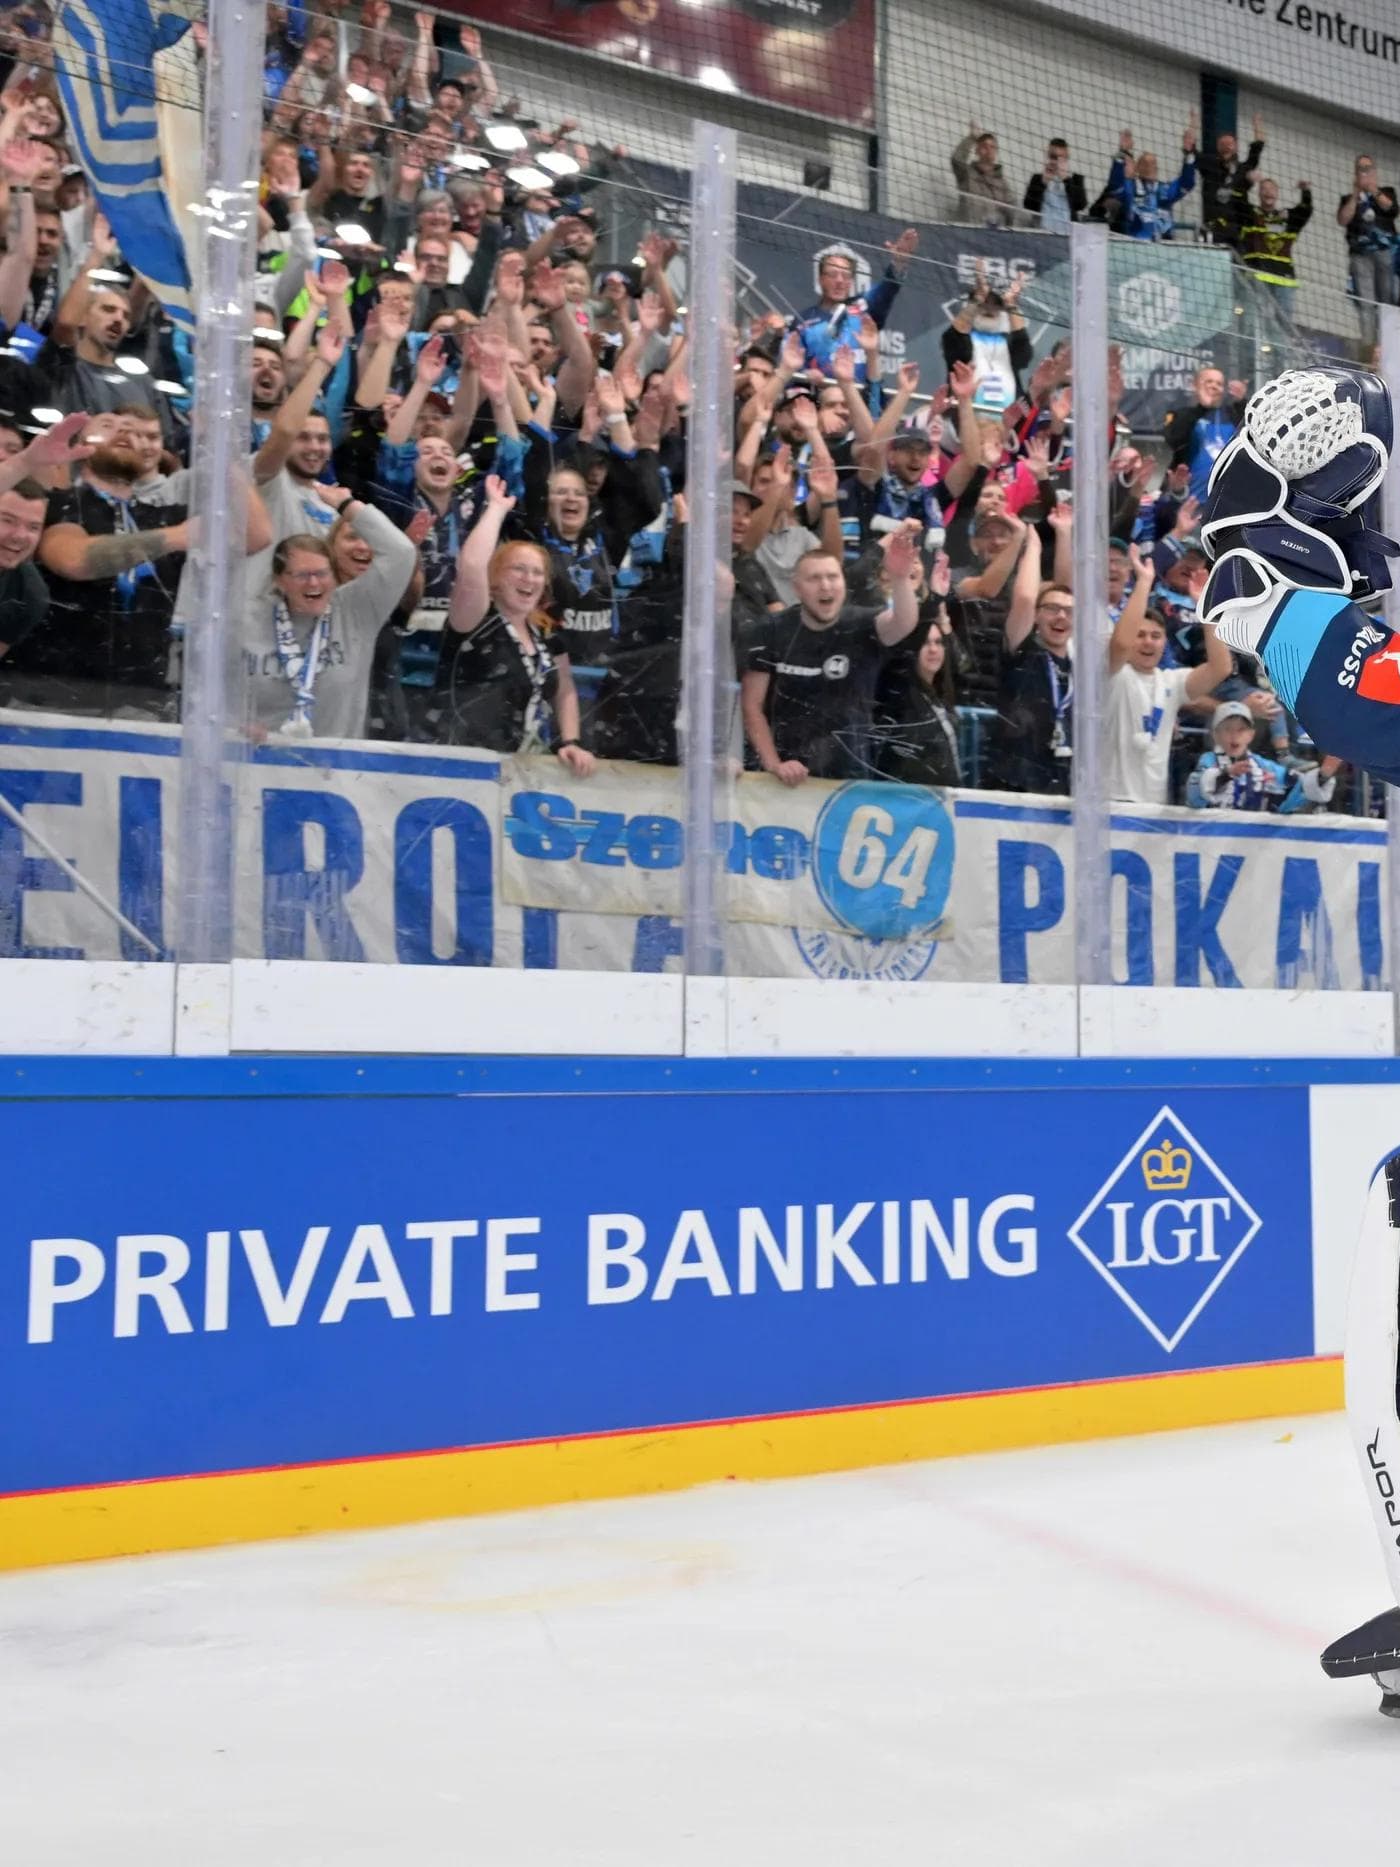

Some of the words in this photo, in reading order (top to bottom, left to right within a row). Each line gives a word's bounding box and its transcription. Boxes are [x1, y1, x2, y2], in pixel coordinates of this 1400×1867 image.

[838, 825, 939, 910] 64
[27, 1217, 542, 1344] PRIVATE
[587, 1194, 1038, 1305] BANKING
[1106, 1198, 1232, 1269] LGT
